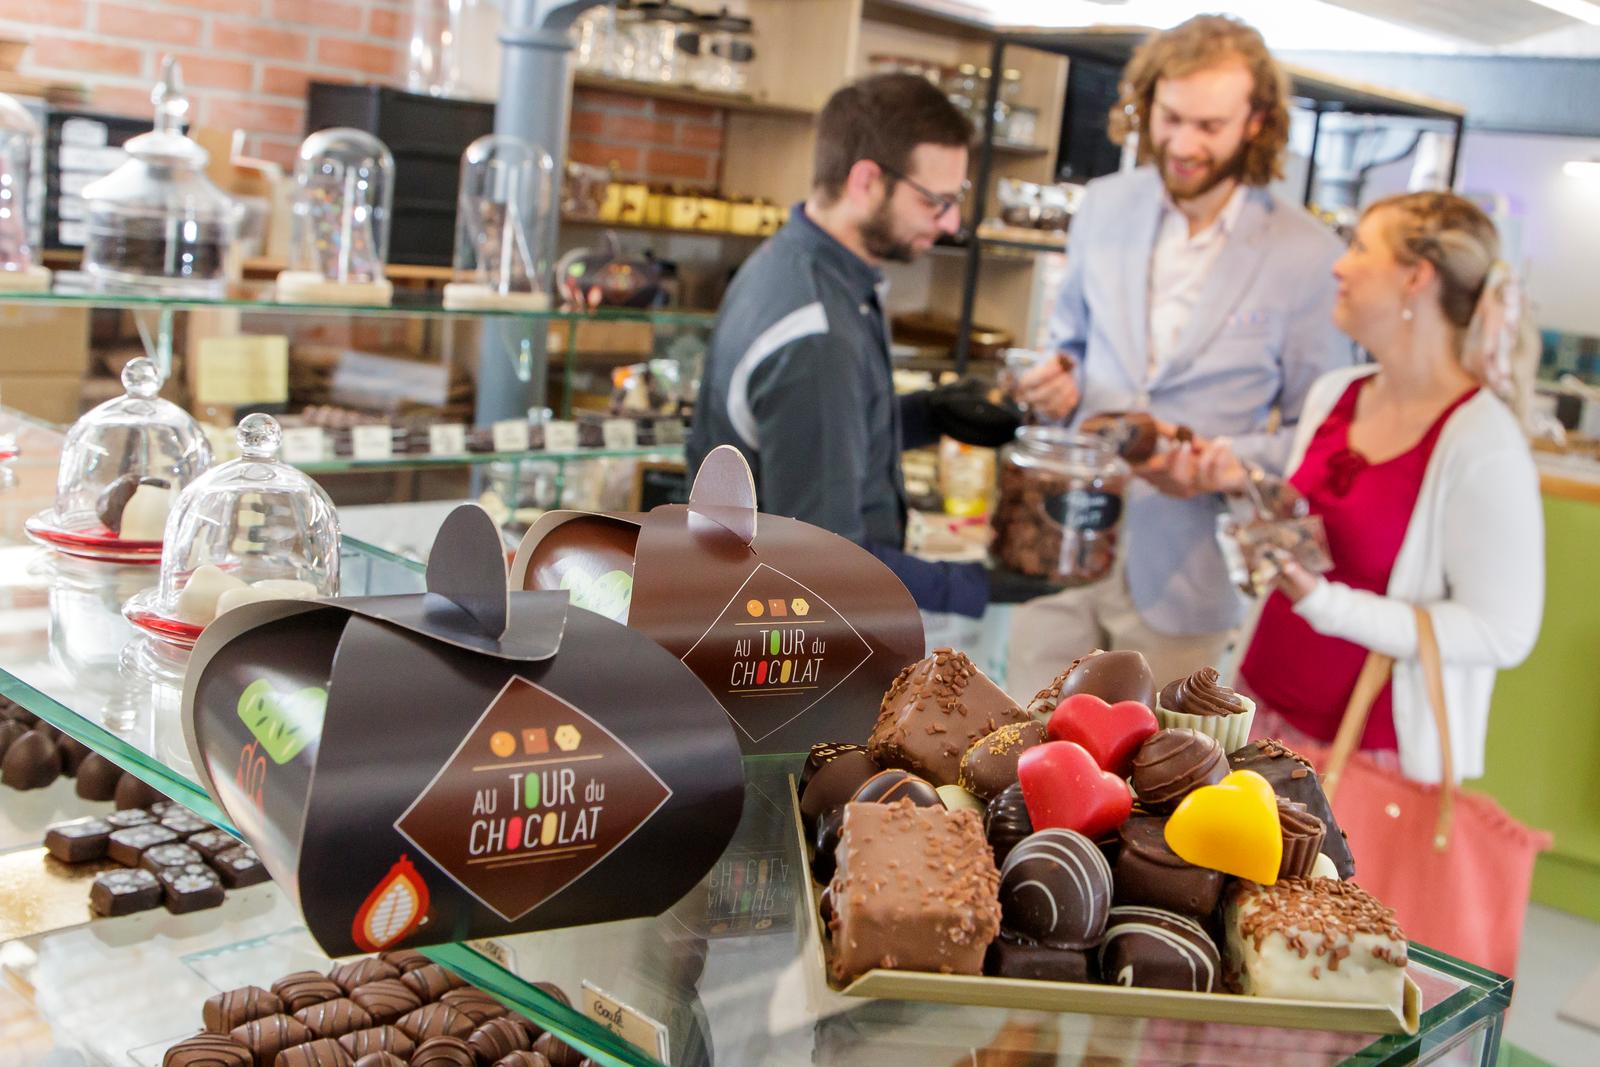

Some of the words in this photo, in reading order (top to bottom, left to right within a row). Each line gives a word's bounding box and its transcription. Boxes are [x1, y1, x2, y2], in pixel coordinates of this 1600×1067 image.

[734, 639, 751, 658] AU
[759, 628, 805, 657] TOUR
[812, 637, 826, 655] du
[731, 658, 824, 686] CHOCOLAT
[472, 788, 497, 816] AU
[508, 767, 576, 811] TOUR
[585, 777, 605, 803] du
[468, 806, 603, 855] CHOCOLAT
